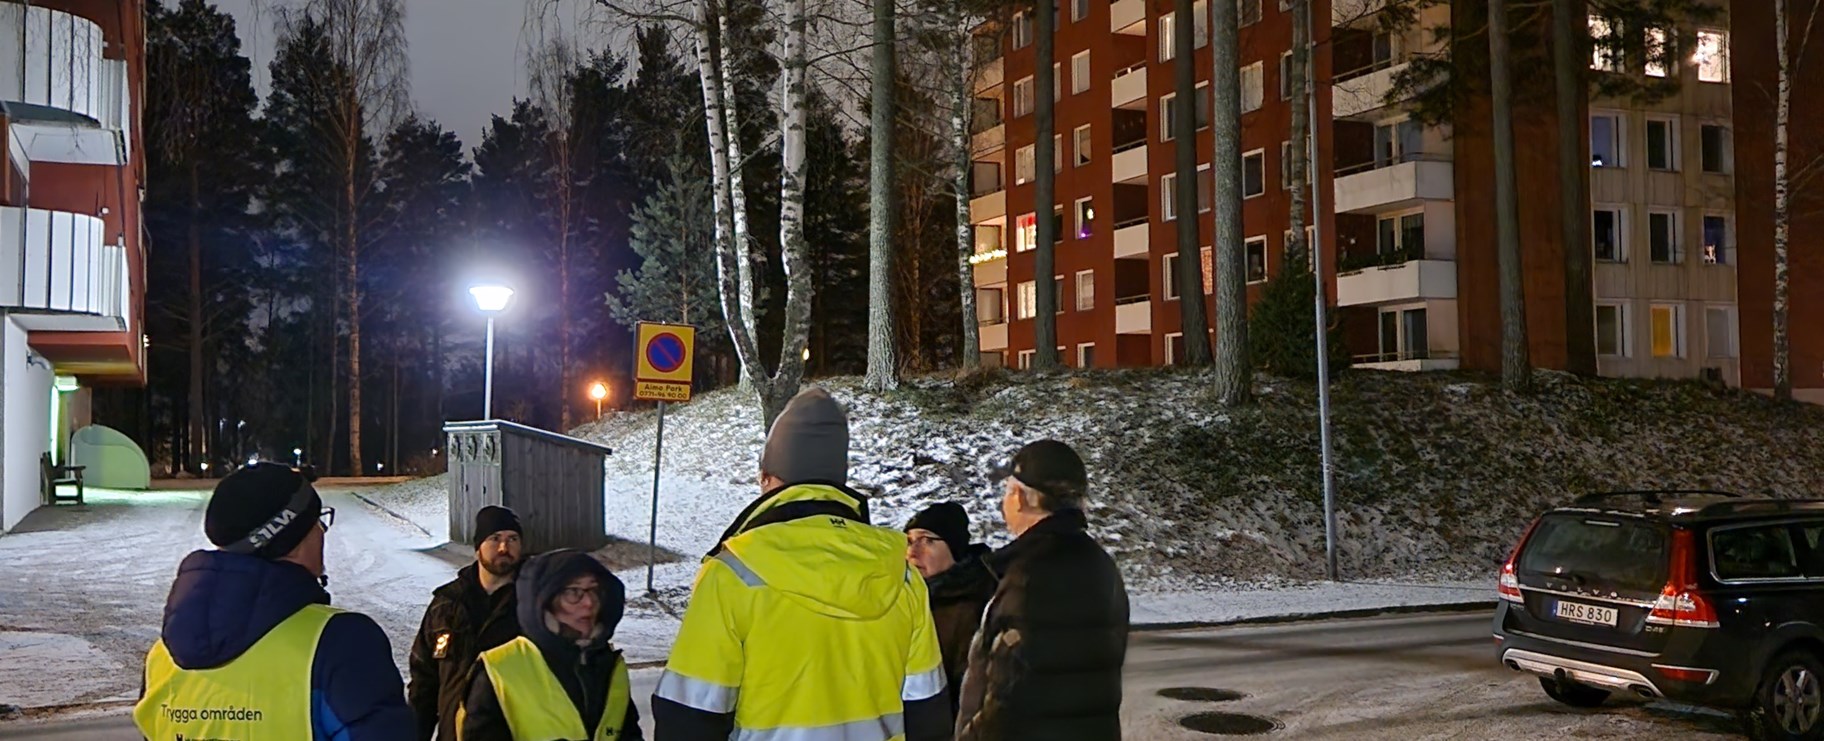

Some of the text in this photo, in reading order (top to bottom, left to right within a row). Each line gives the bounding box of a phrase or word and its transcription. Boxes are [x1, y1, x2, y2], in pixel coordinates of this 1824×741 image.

[1546, 582, 1618, 598] VOLVO
[1560, 602, 1584, 618] HRS
[1586, 607, 1612, 622] 830
[161, 704, 262, 723] Trygga områden
